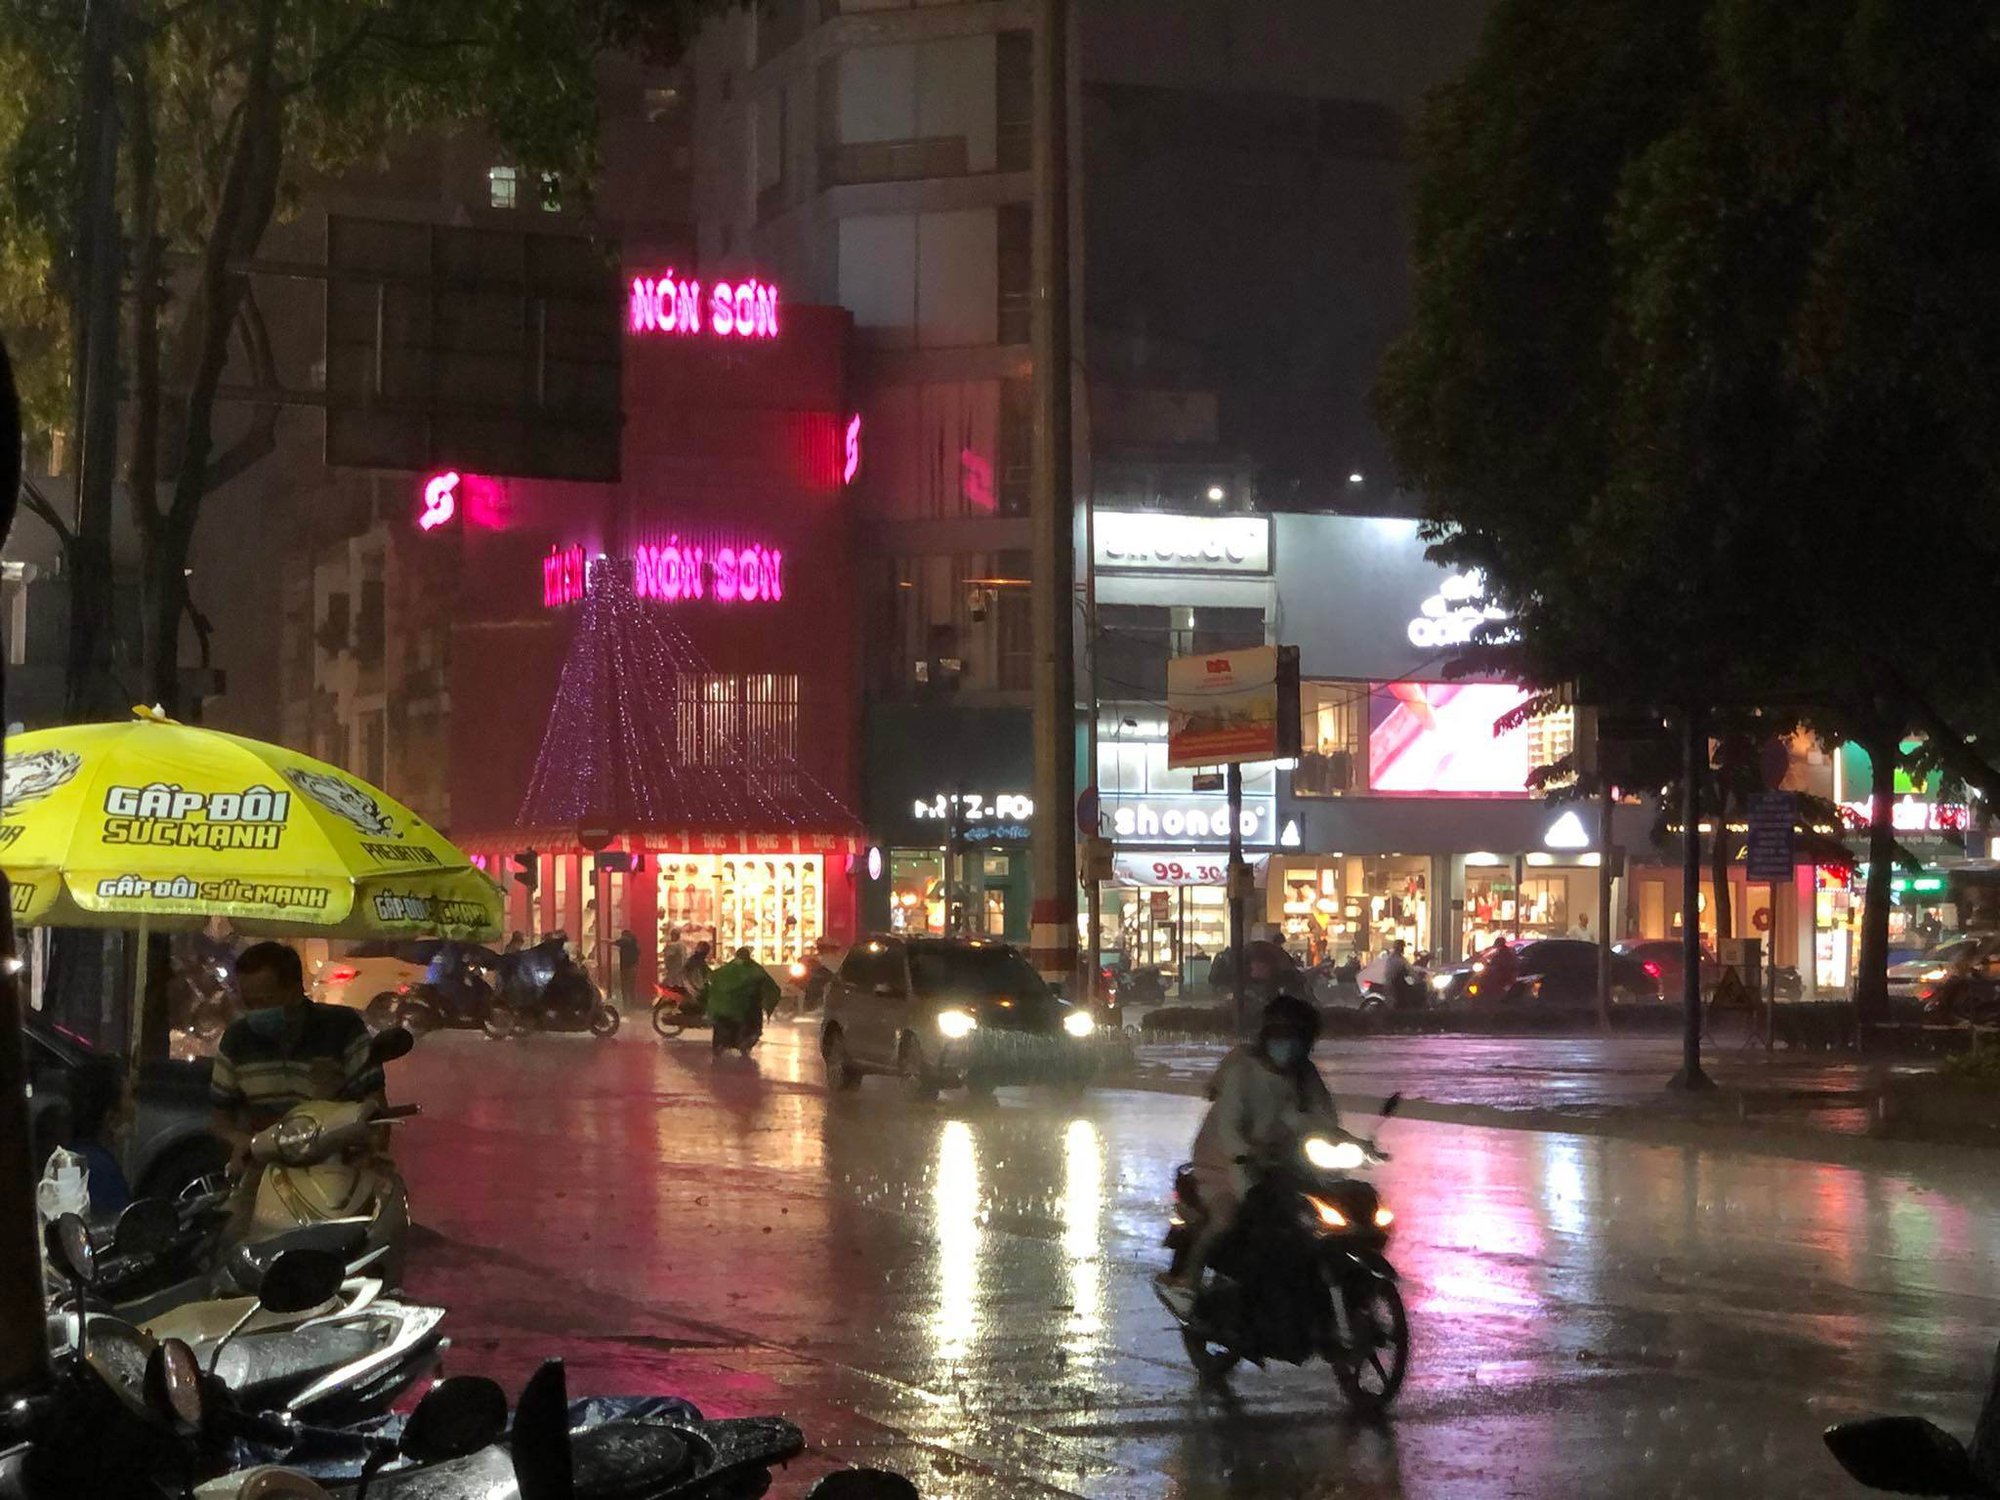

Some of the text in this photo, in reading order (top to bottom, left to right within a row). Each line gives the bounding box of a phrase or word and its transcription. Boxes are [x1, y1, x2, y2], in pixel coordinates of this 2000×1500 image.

[632, 267, 700, 334] NÓN
[635, 533, 704, 600] NÓN
[104, 782, 290, 823] GẤP ĐÔI
[1114, 804, 1258, 836] shondo
[102, 817, 282, 851] SỨC MẠNH
[360, 842, 442, 867] PREDATOR
[97, 874, 151, 898] GẤP
[151, 876, 199, 899] ĐÔI
[253, 884, 328, 909] MẠNH
